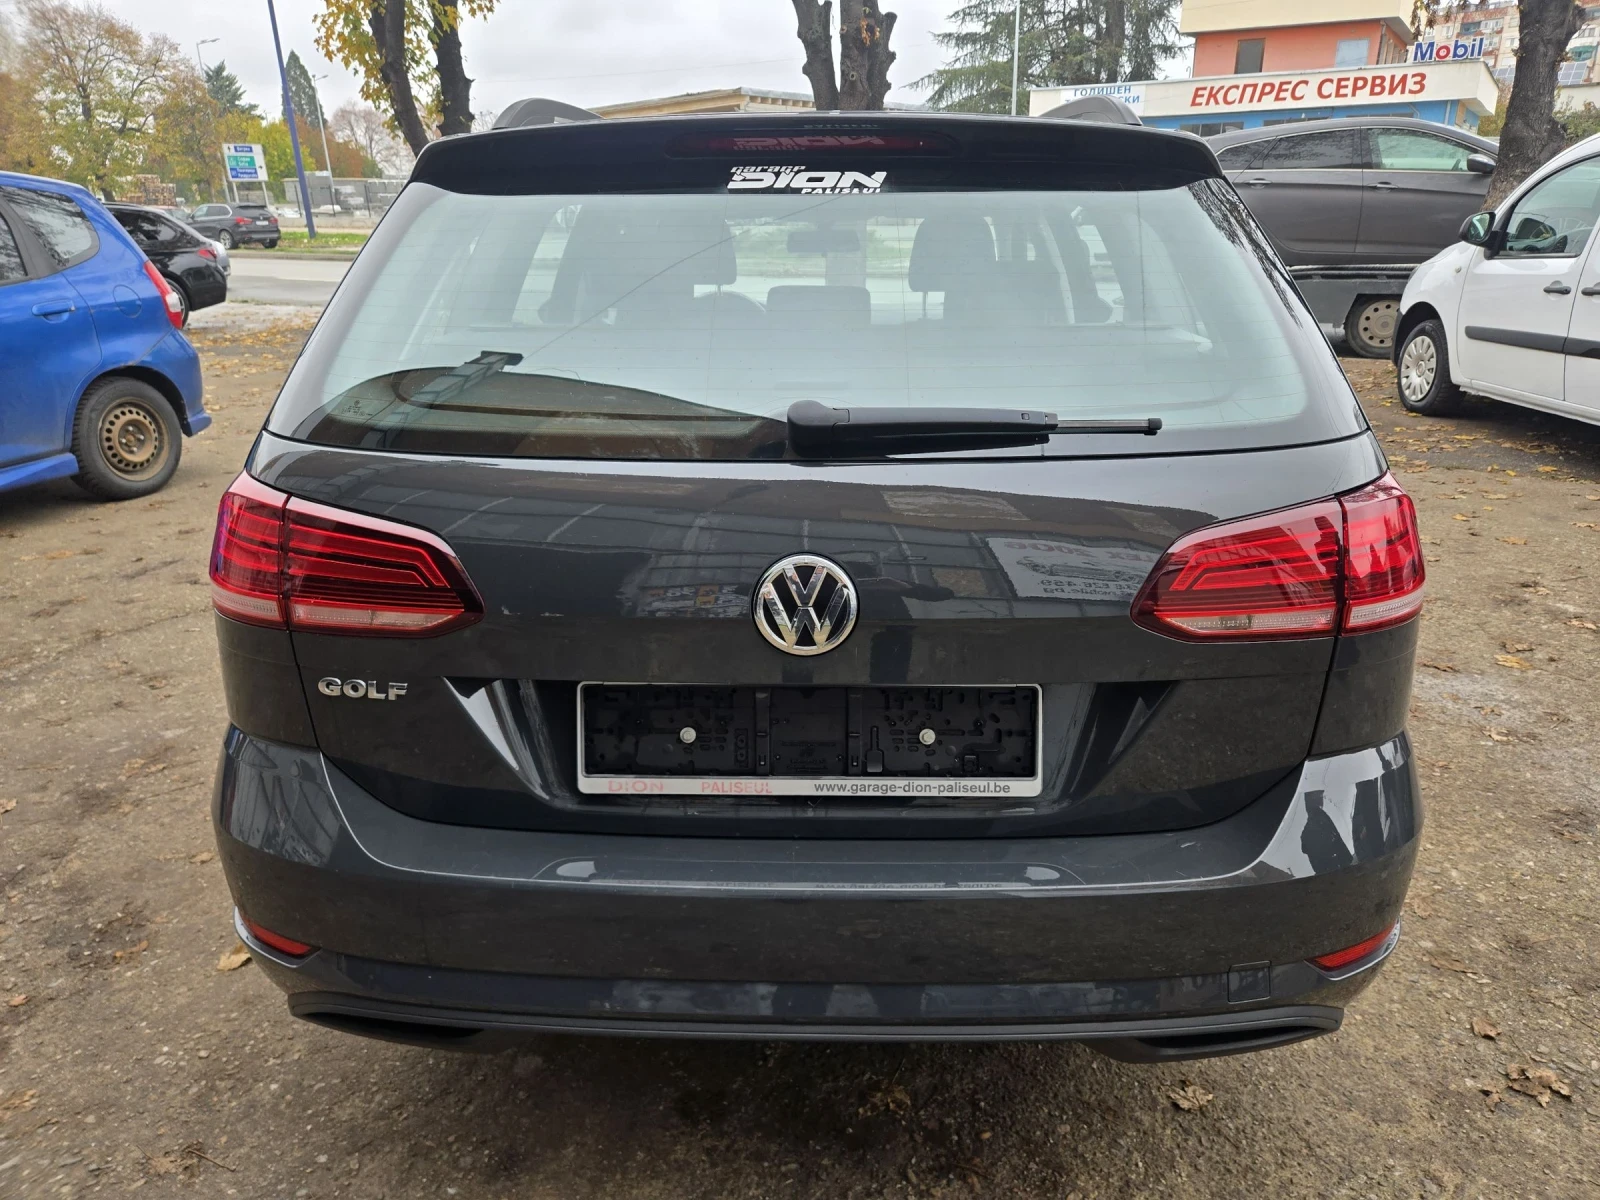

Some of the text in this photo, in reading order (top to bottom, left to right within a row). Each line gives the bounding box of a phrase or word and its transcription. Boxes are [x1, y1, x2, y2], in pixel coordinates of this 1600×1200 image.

[1412, 37, 1485, 62] Mobil
[1190, 72, 1427, 107] ЕКСПРЕС СЕРВИЗ
[318, 677, 408, 700] GOLF
[608, 780, 773, 794] DION PALISEUL
[814, 782, 1011, 795] www.garage-dion-paliseul.be
